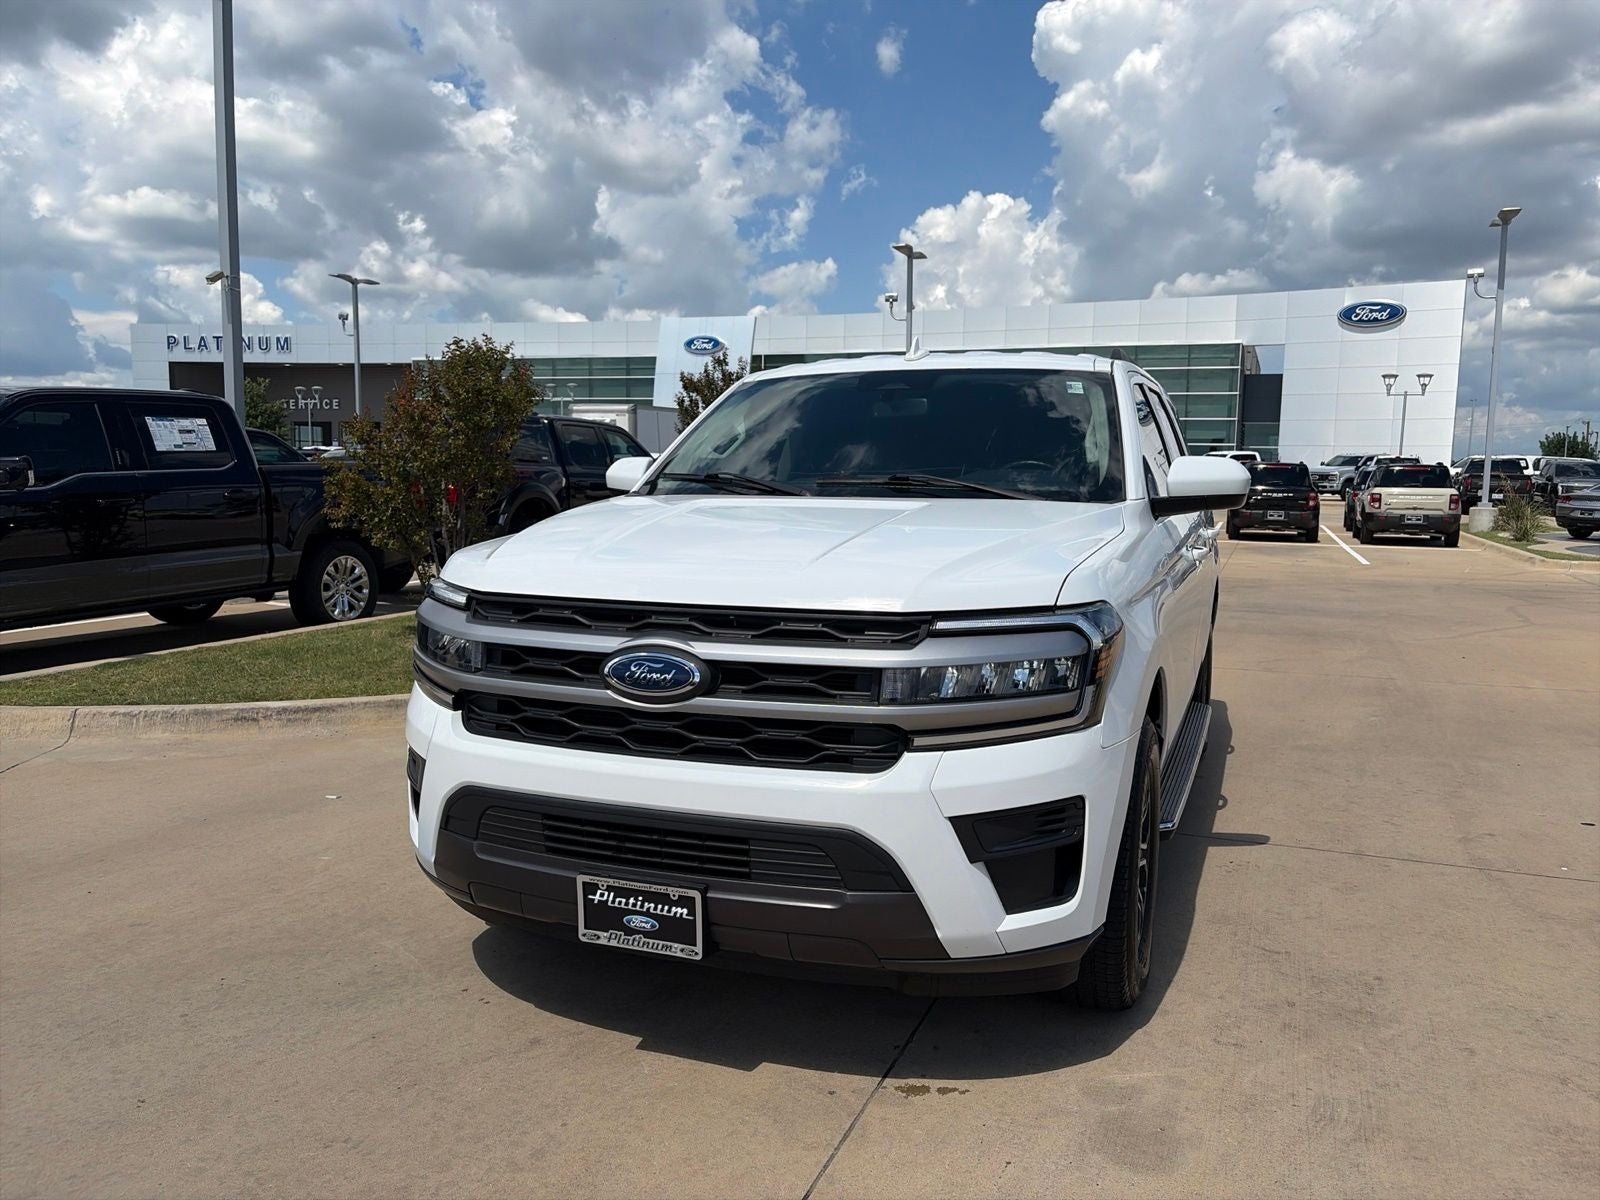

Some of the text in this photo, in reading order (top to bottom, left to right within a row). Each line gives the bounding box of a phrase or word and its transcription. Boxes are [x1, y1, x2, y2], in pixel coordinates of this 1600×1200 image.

[1351, 305, 1391, 321] Ford
[166, 335, 292, 352] PLATNUM
[690, 338, 715, 350] Ford
[624, 660, 676, 686] Ford
[587, 889, 694, 920] Platinum
[630, 917, 652, 929] Ford
[604, 930, 678, 954] Platinum
